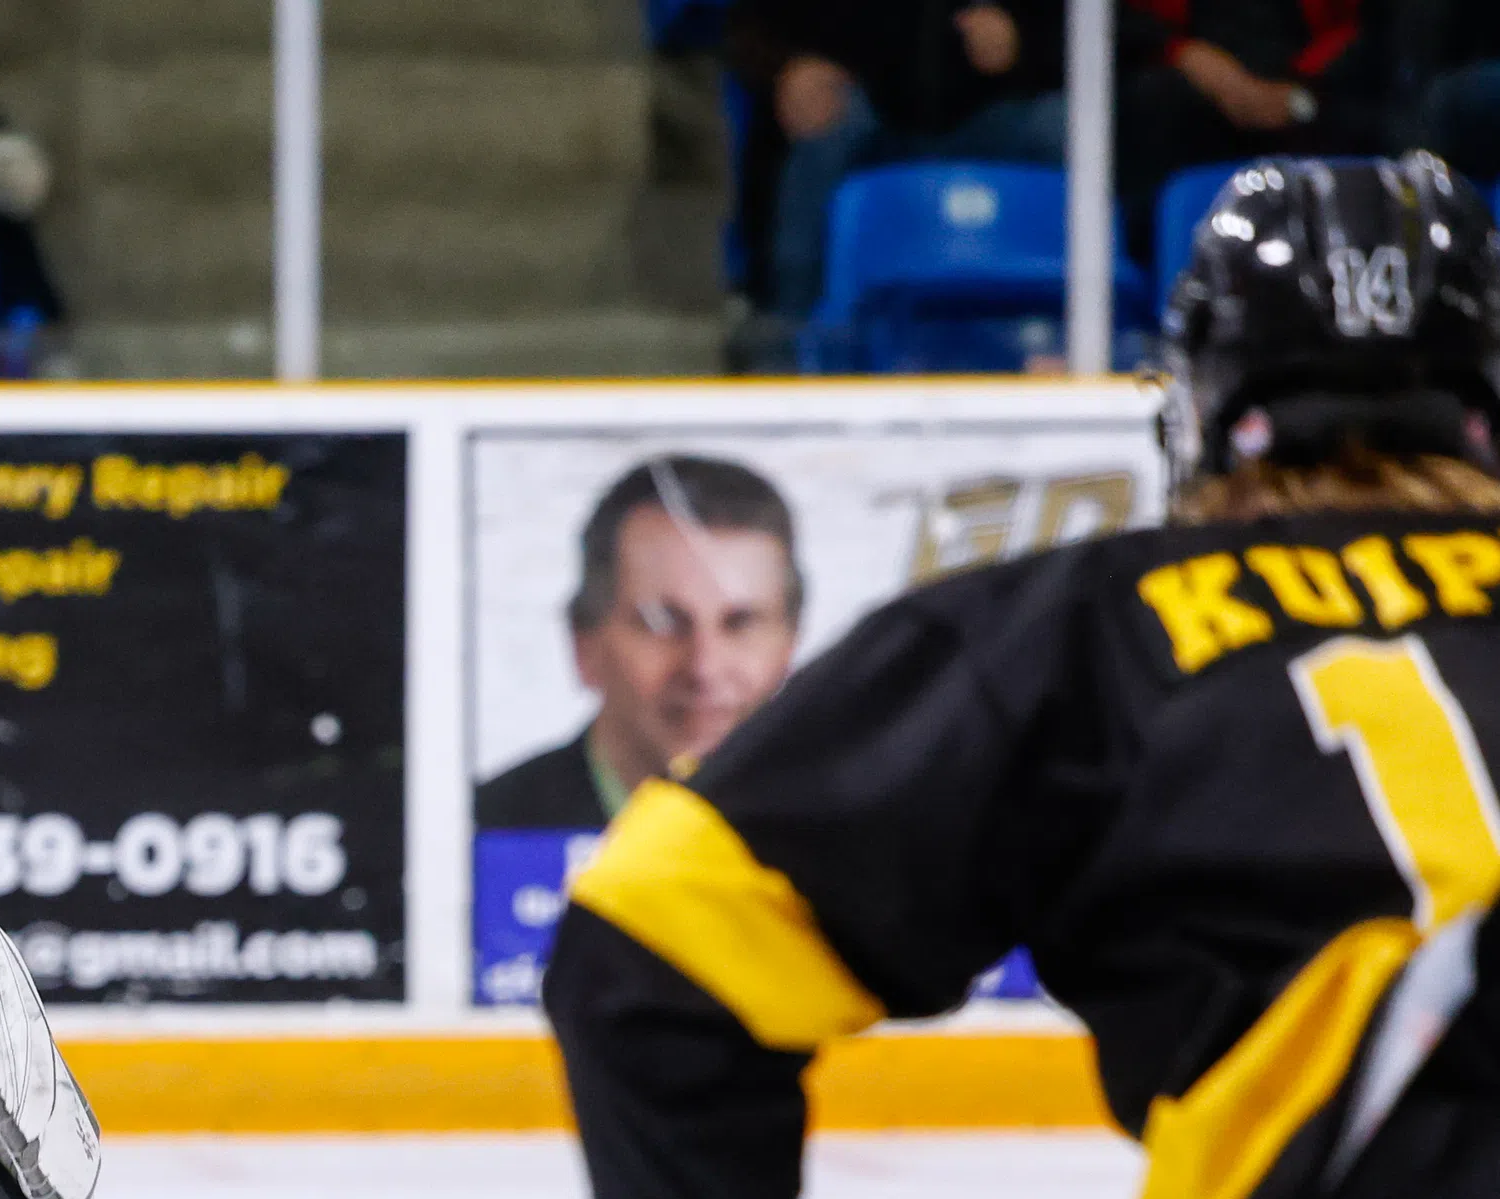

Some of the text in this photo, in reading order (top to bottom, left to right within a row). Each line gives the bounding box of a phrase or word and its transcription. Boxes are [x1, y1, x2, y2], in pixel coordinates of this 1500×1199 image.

[93, 452, 288, 518] Repair
[1136, 530, 1500, 674] KUIP
[16, 920, 378, 990] @gmail.com
